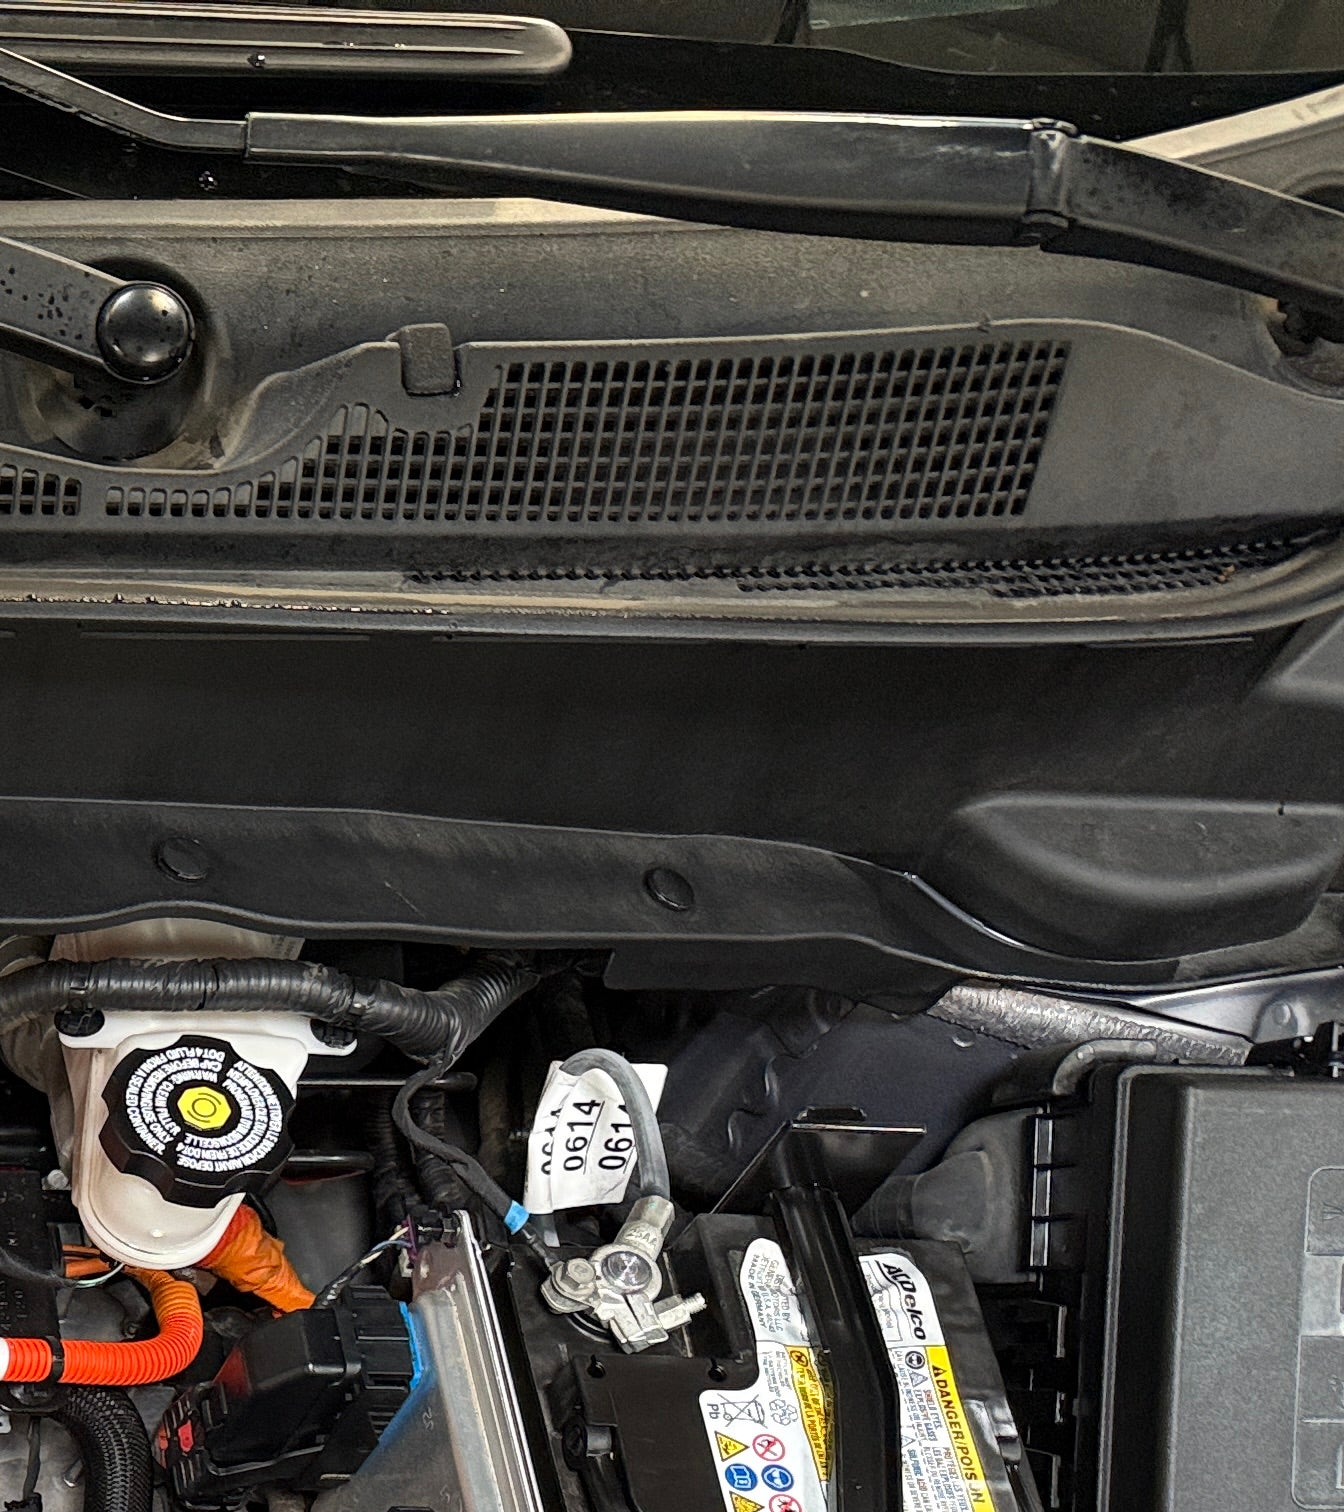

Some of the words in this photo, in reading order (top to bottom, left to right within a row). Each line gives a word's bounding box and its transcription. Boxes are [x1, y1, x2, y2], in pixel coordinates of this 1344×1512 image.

[138, 1052, 169, 1073] FROM
[162, 1046, 196, 1061] FLUID
[198, 1057, 223, 1072] CAP
[201, 1047, 227, 1063] DOT
[158, 1057, 199, 1075] BEFORE
[125, 1073, 144, 1107] SEALED
[154, 1079, 175, 1107] CLEAN
[139, 1106, 158, 1124] USE
[155, 1107, 183, 1137] FILLER
[126, 1106, 170, 1156] CONTAINER
[146, 1122, 175, 1145] ONLY
[564, 1099, 601, 1171] 0614
[883, 1262, 926, 1341] ACDelco
[707, 1402, 721, 1420] Pb
